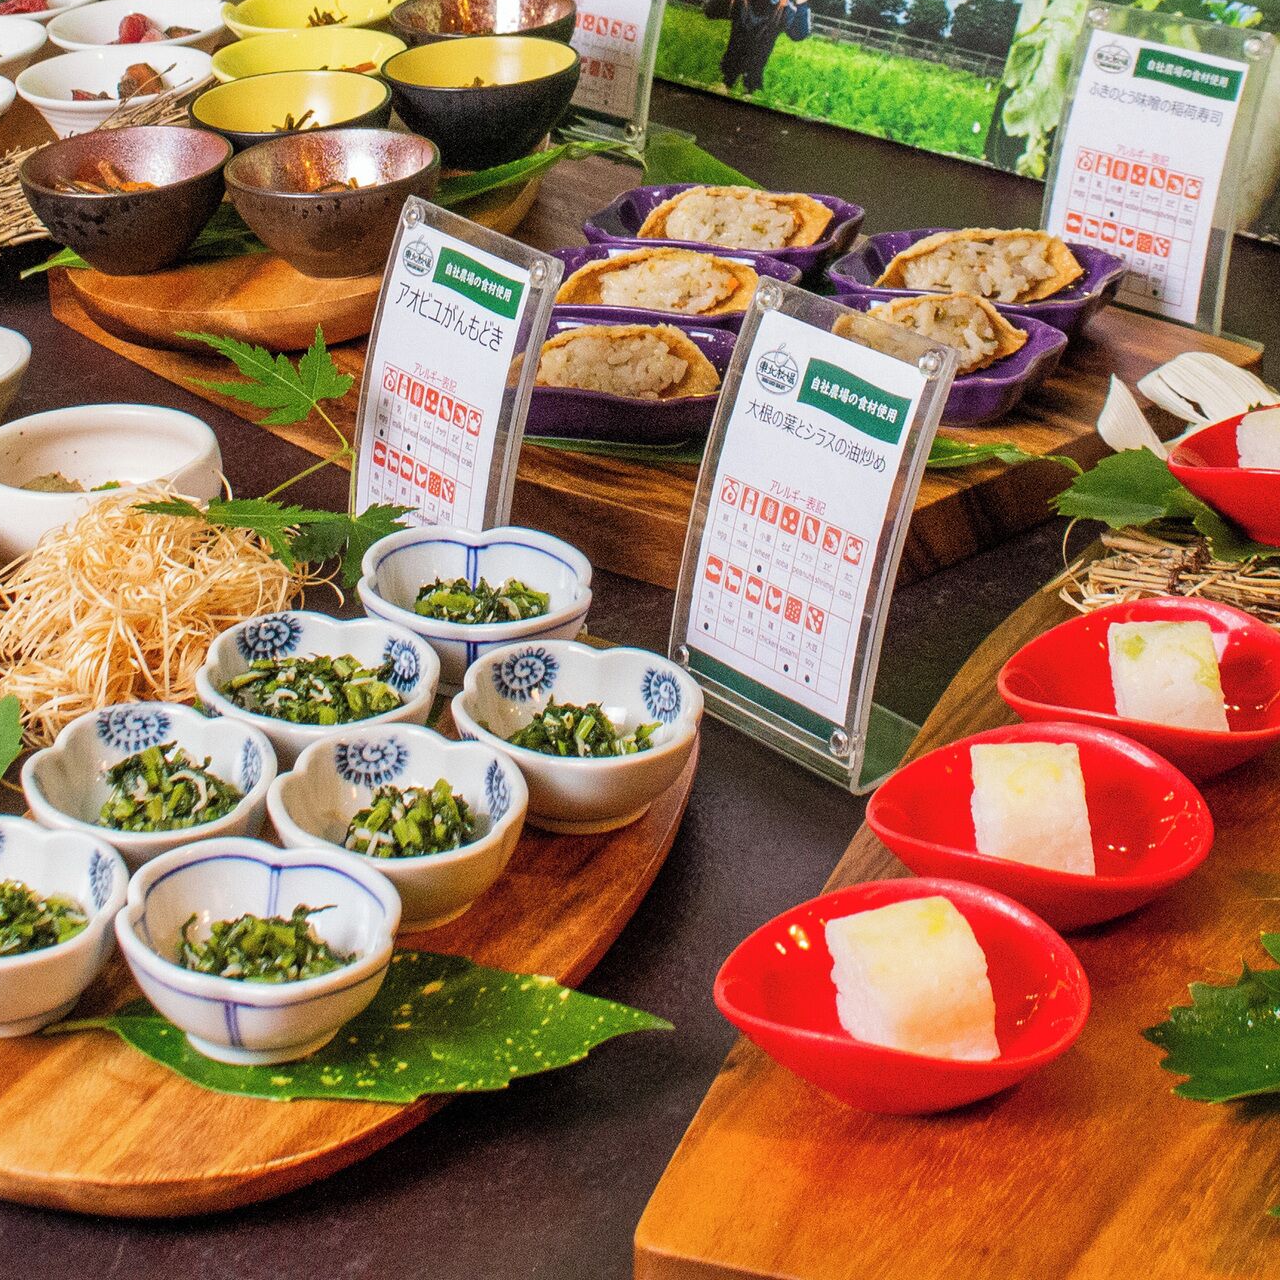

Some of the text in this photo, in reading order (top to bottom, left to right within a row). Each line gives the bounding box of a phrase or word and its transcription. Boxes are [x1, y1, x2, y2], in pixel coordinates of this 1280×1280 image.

[444, 262, 513, 303] 自社農場の食材使用
[395, 281, 504, 352] アオビユがんもどき
[810, 375, 899, 424] 自社農場の食材使用
[744, 398, 887, 473] 大根の葉とシラスの油炒め
[769, 479, 828, 516] アレルギー表記
